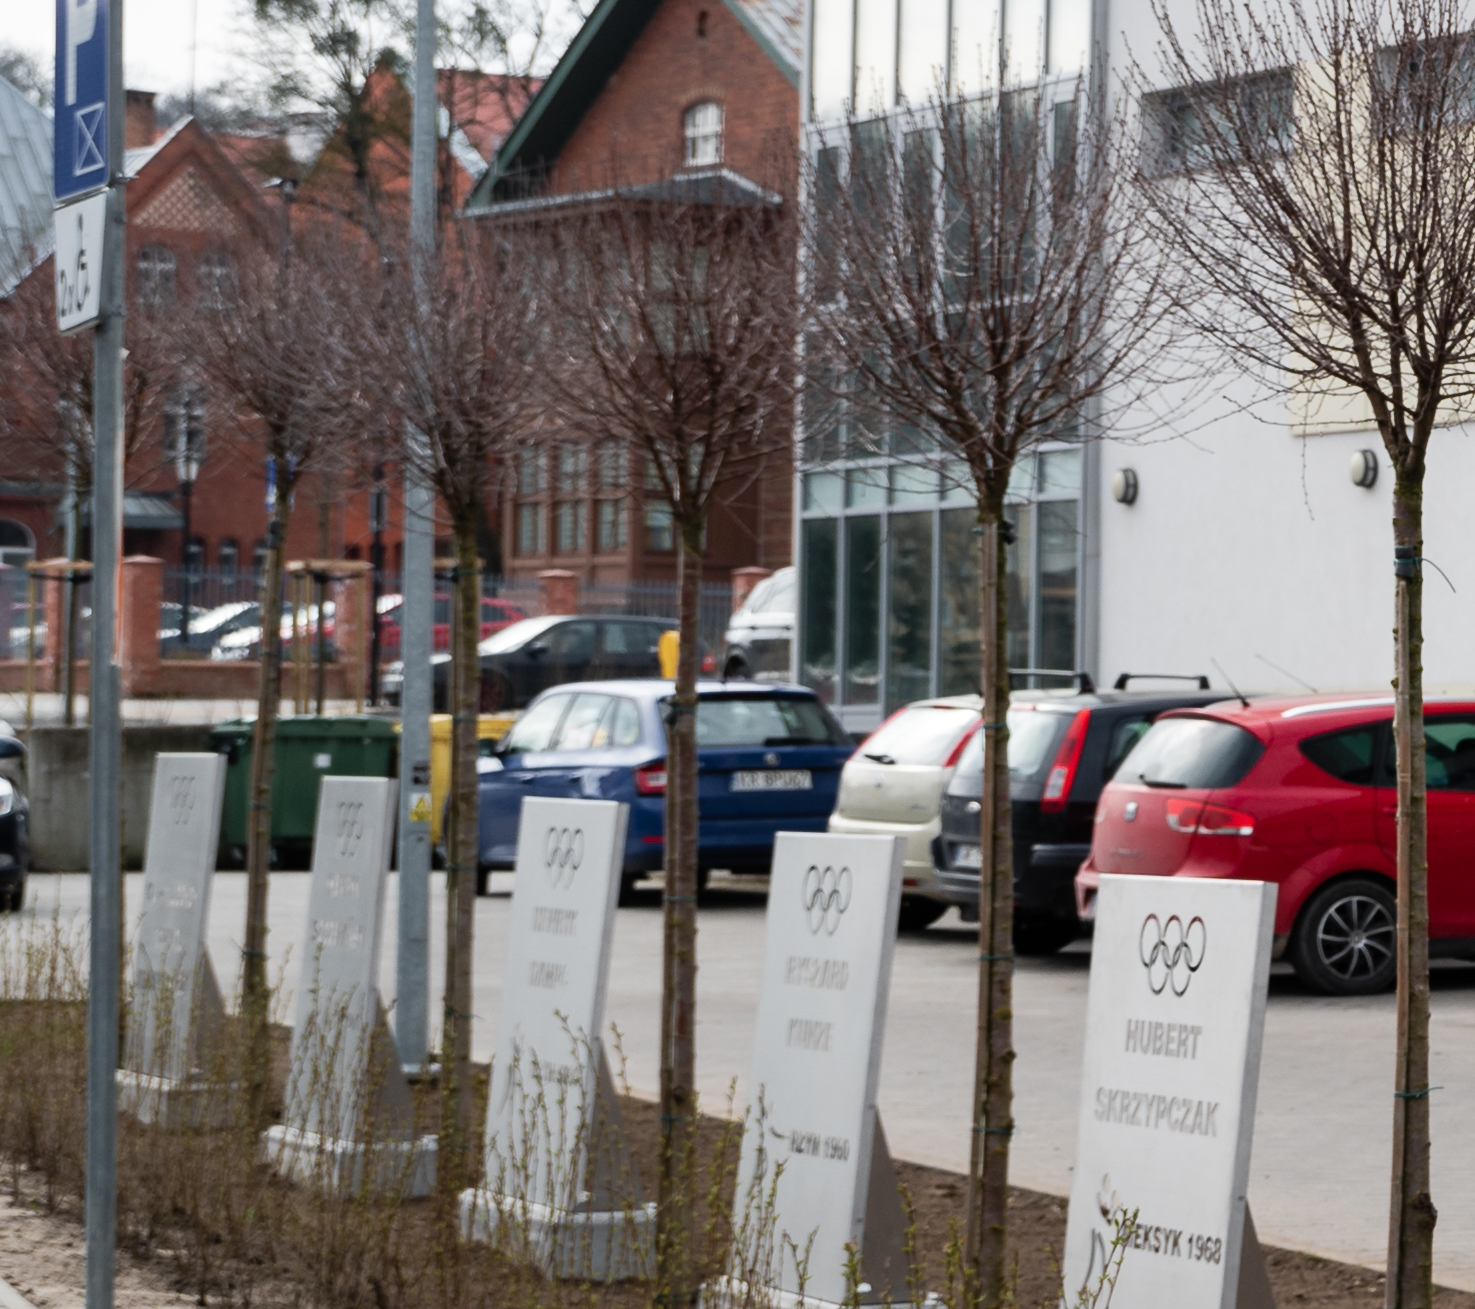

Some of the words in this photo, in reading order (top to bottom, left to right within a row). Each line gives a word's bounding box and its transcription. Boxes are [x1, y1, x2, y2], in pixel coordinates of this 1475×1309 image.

[1124, 1018, 1203, 1061] HUBERT
[1093, 1086, 1221, 1138] SKRZYPCZAK
[1187, 1235, 1223, 1266] 1968
